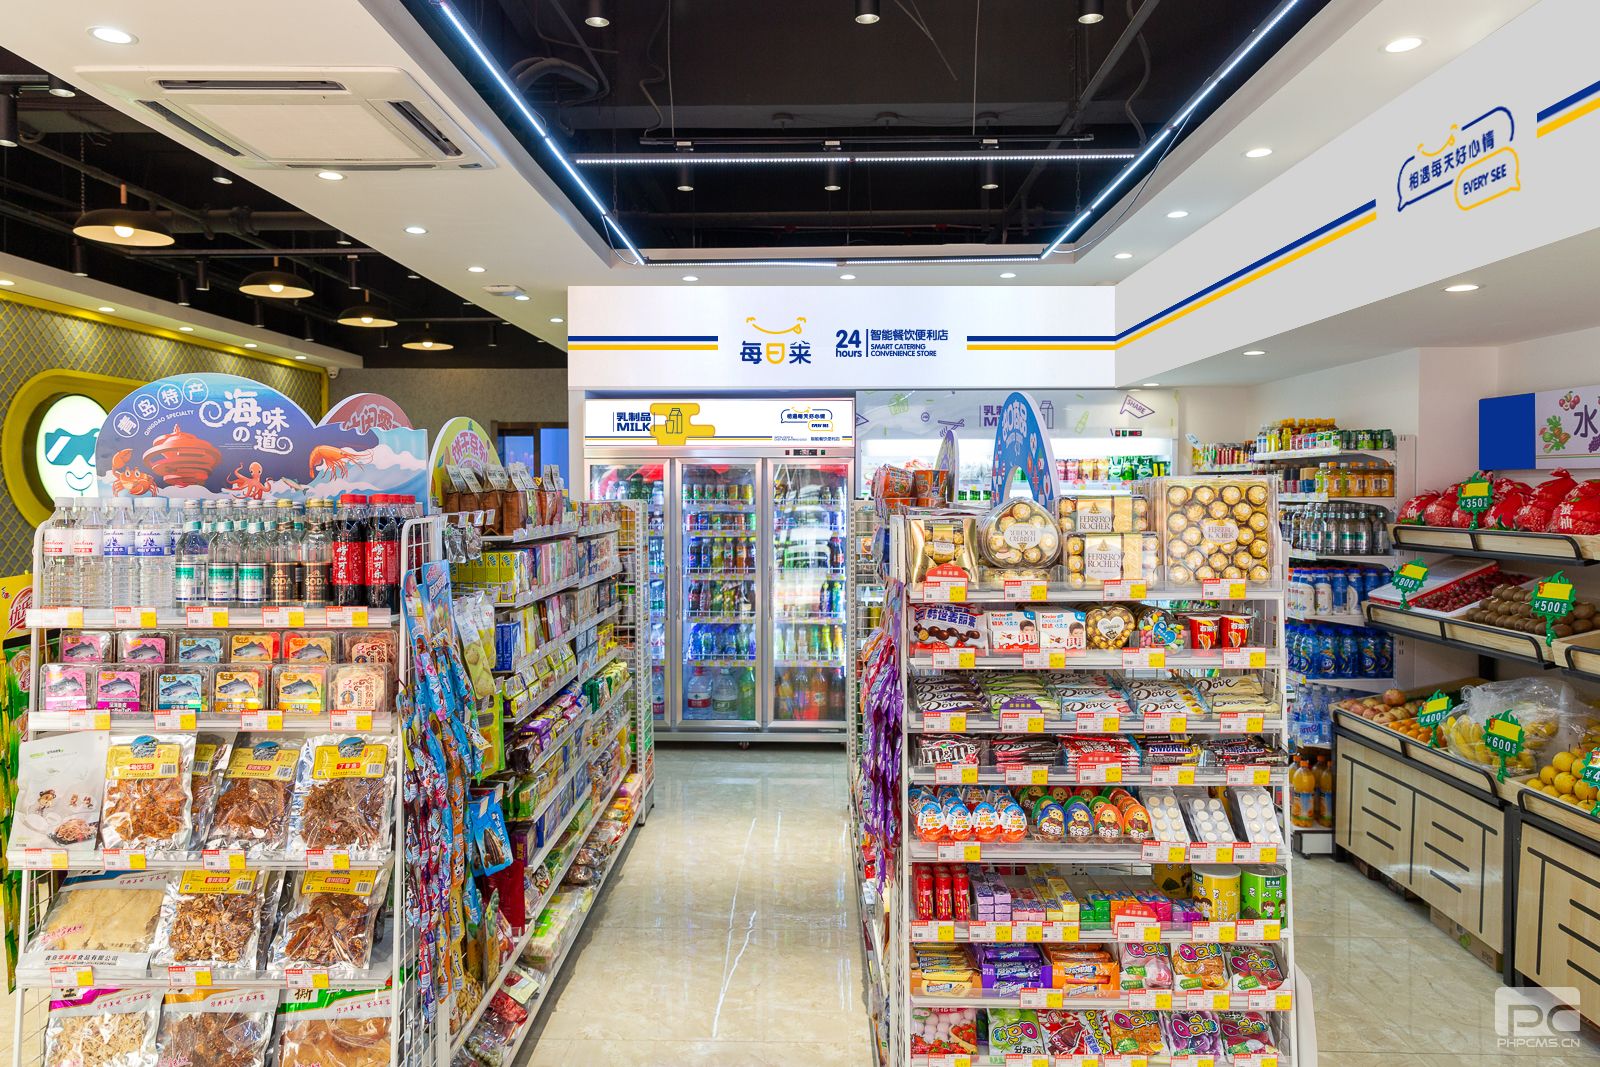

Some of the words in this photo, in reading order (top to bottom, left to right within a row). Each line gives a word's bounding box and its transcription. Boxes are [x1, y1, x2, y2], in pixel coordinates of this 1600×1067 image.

[1408, 130, 1495, 191] 相遇每天好心情
[1463, 172, 1489, 196] EVERY
[1490, 164, 1507, 183] SEE
[835, 329, 862, 348] 24
[870, 329, 949, 341] 智能餐饮便利店
[835, 347, 862, 358] hours
[117, 382, 206, 436] 青岛特产
[1126, 398, 1147, 415] SHARE
[143, 416, 165, 437] QINGDAO
[166, 408, 195, 421] SPECIALTY
[616, 411, 652, 422] 乳制品
[1573, 404, 1599, 438] 水
[616, 422, 651, 432] MILK
[1079, 515, 1111, 523] FERRERO
[1079, 522, 1111, 530] ROCHER
[1087, 553, 1121, 561] FERRERO
[1087, 560, 1120, 568] ROCHER
[304, 577, 329, 586] SODA
[1534, 600, 1561, 613] ¥500
[1197, 677, 1238, 692] Dove
[1133, 688, 1178, 700] Dove
[921, 701, 963, 711] Dove
[1068, 700, 1112, 712] Dove
[1140, 701, 1185, 712] Dove
[1150, 744, 1192, 754] SNICKERS
[1487, 735, 1511, 752] ¥600
